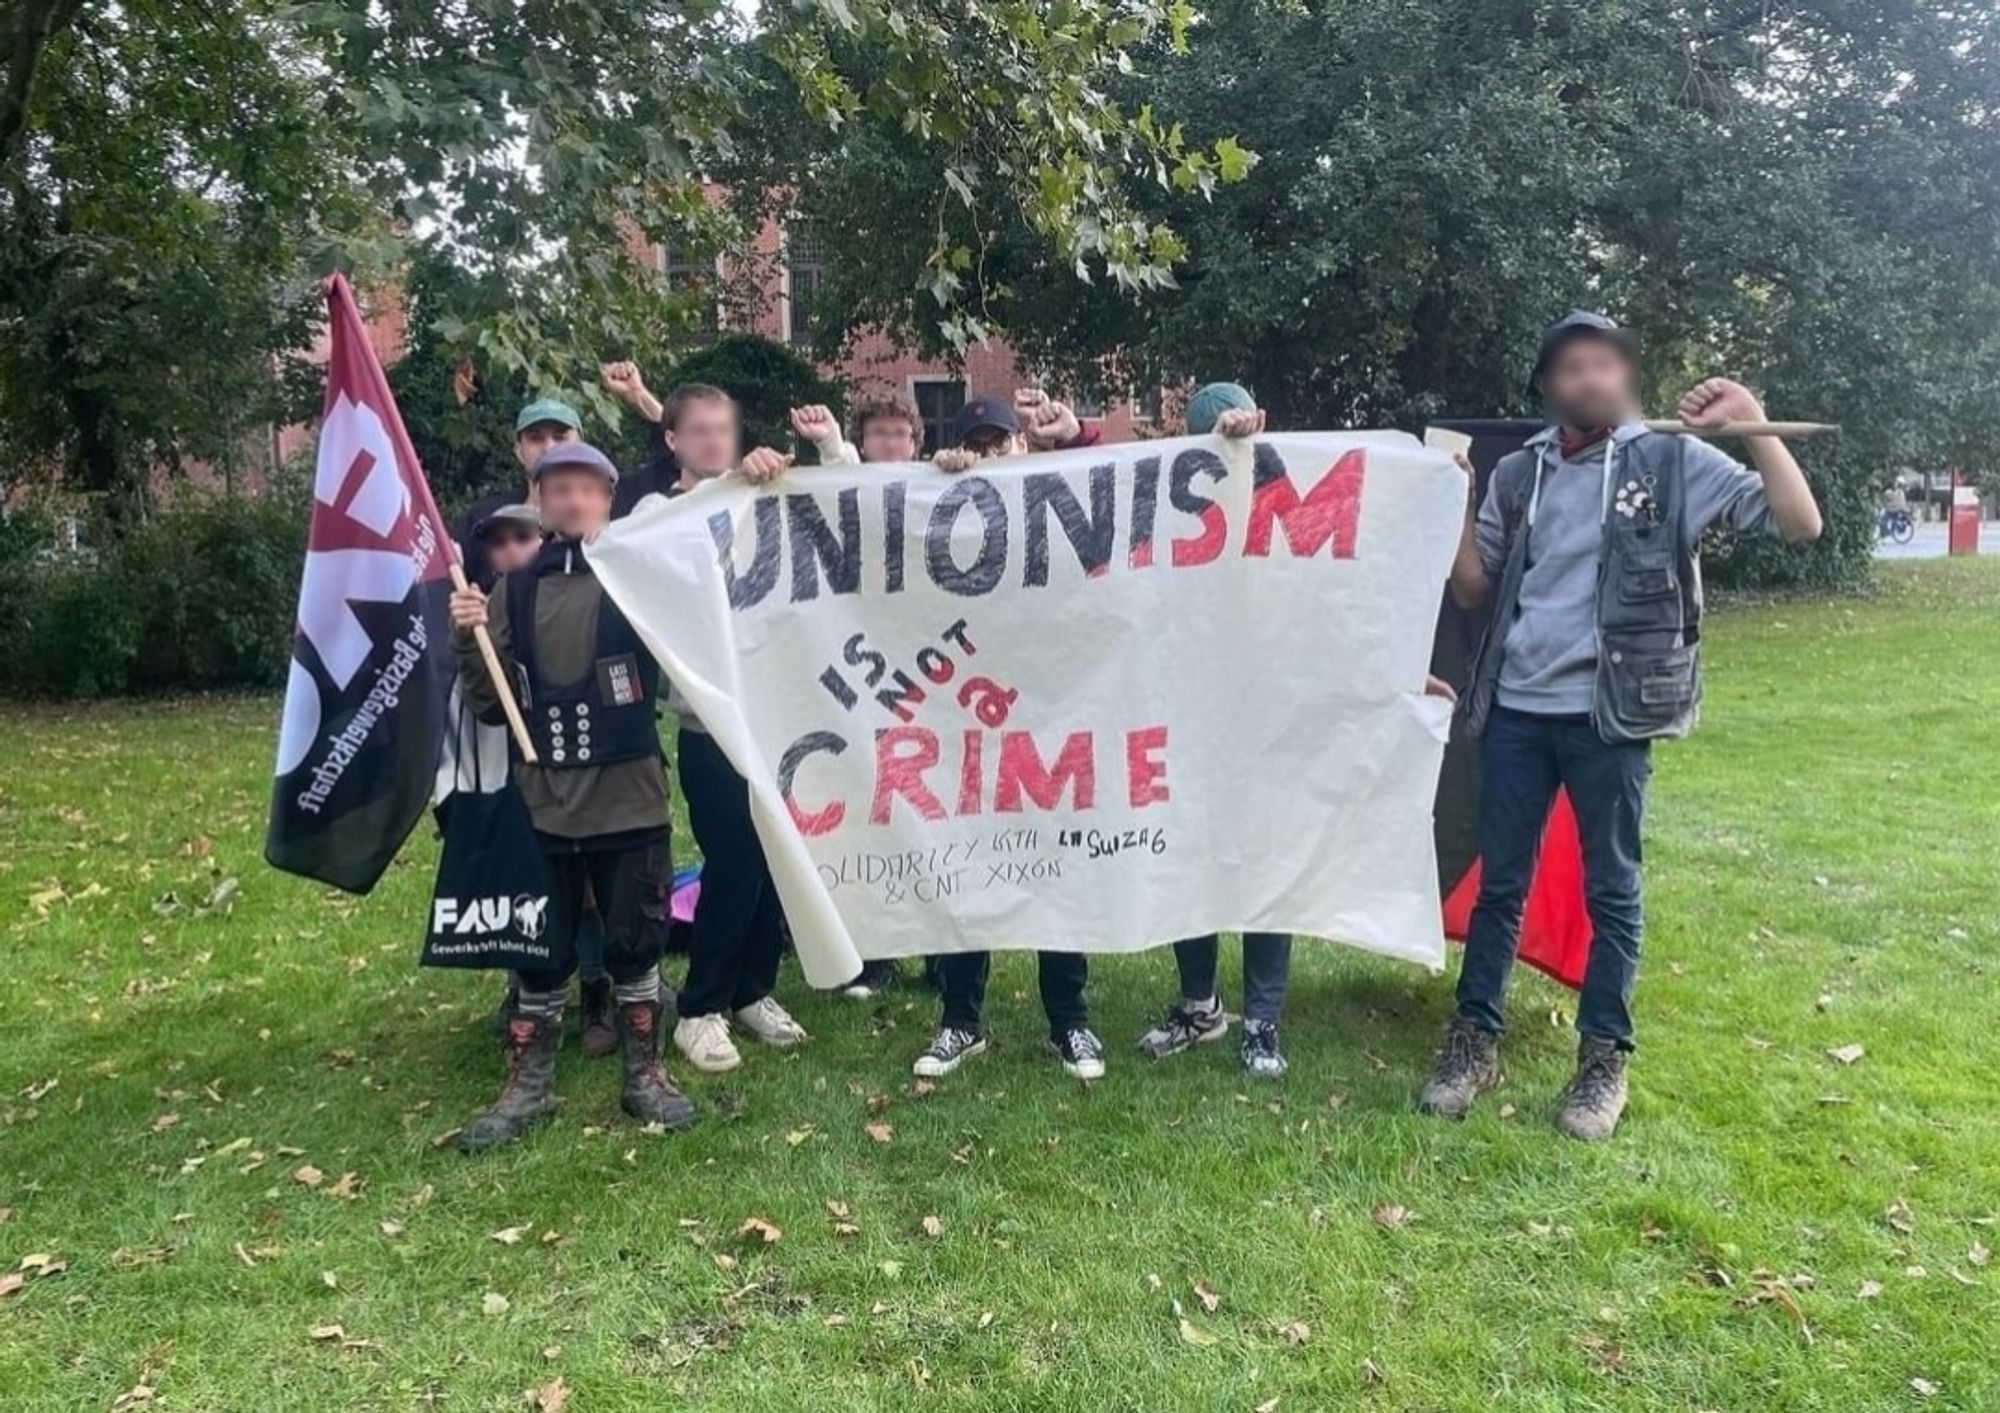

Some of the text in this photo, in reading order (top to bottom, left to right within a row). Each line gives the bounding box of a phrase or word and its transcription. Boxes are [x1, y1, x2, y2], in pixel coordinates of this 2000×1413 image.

[707, 443, 1366, 612] UNIONISM
[819, 632, 887, 712] IS
[875, 618, 978, 723] NOT
[777, 726, 1172, 837] CRIME
[818, 838, 979, 891] OLIDARITY
[914, 867, 970, 904] CNT
[433, 896, 511, 934] FAU
